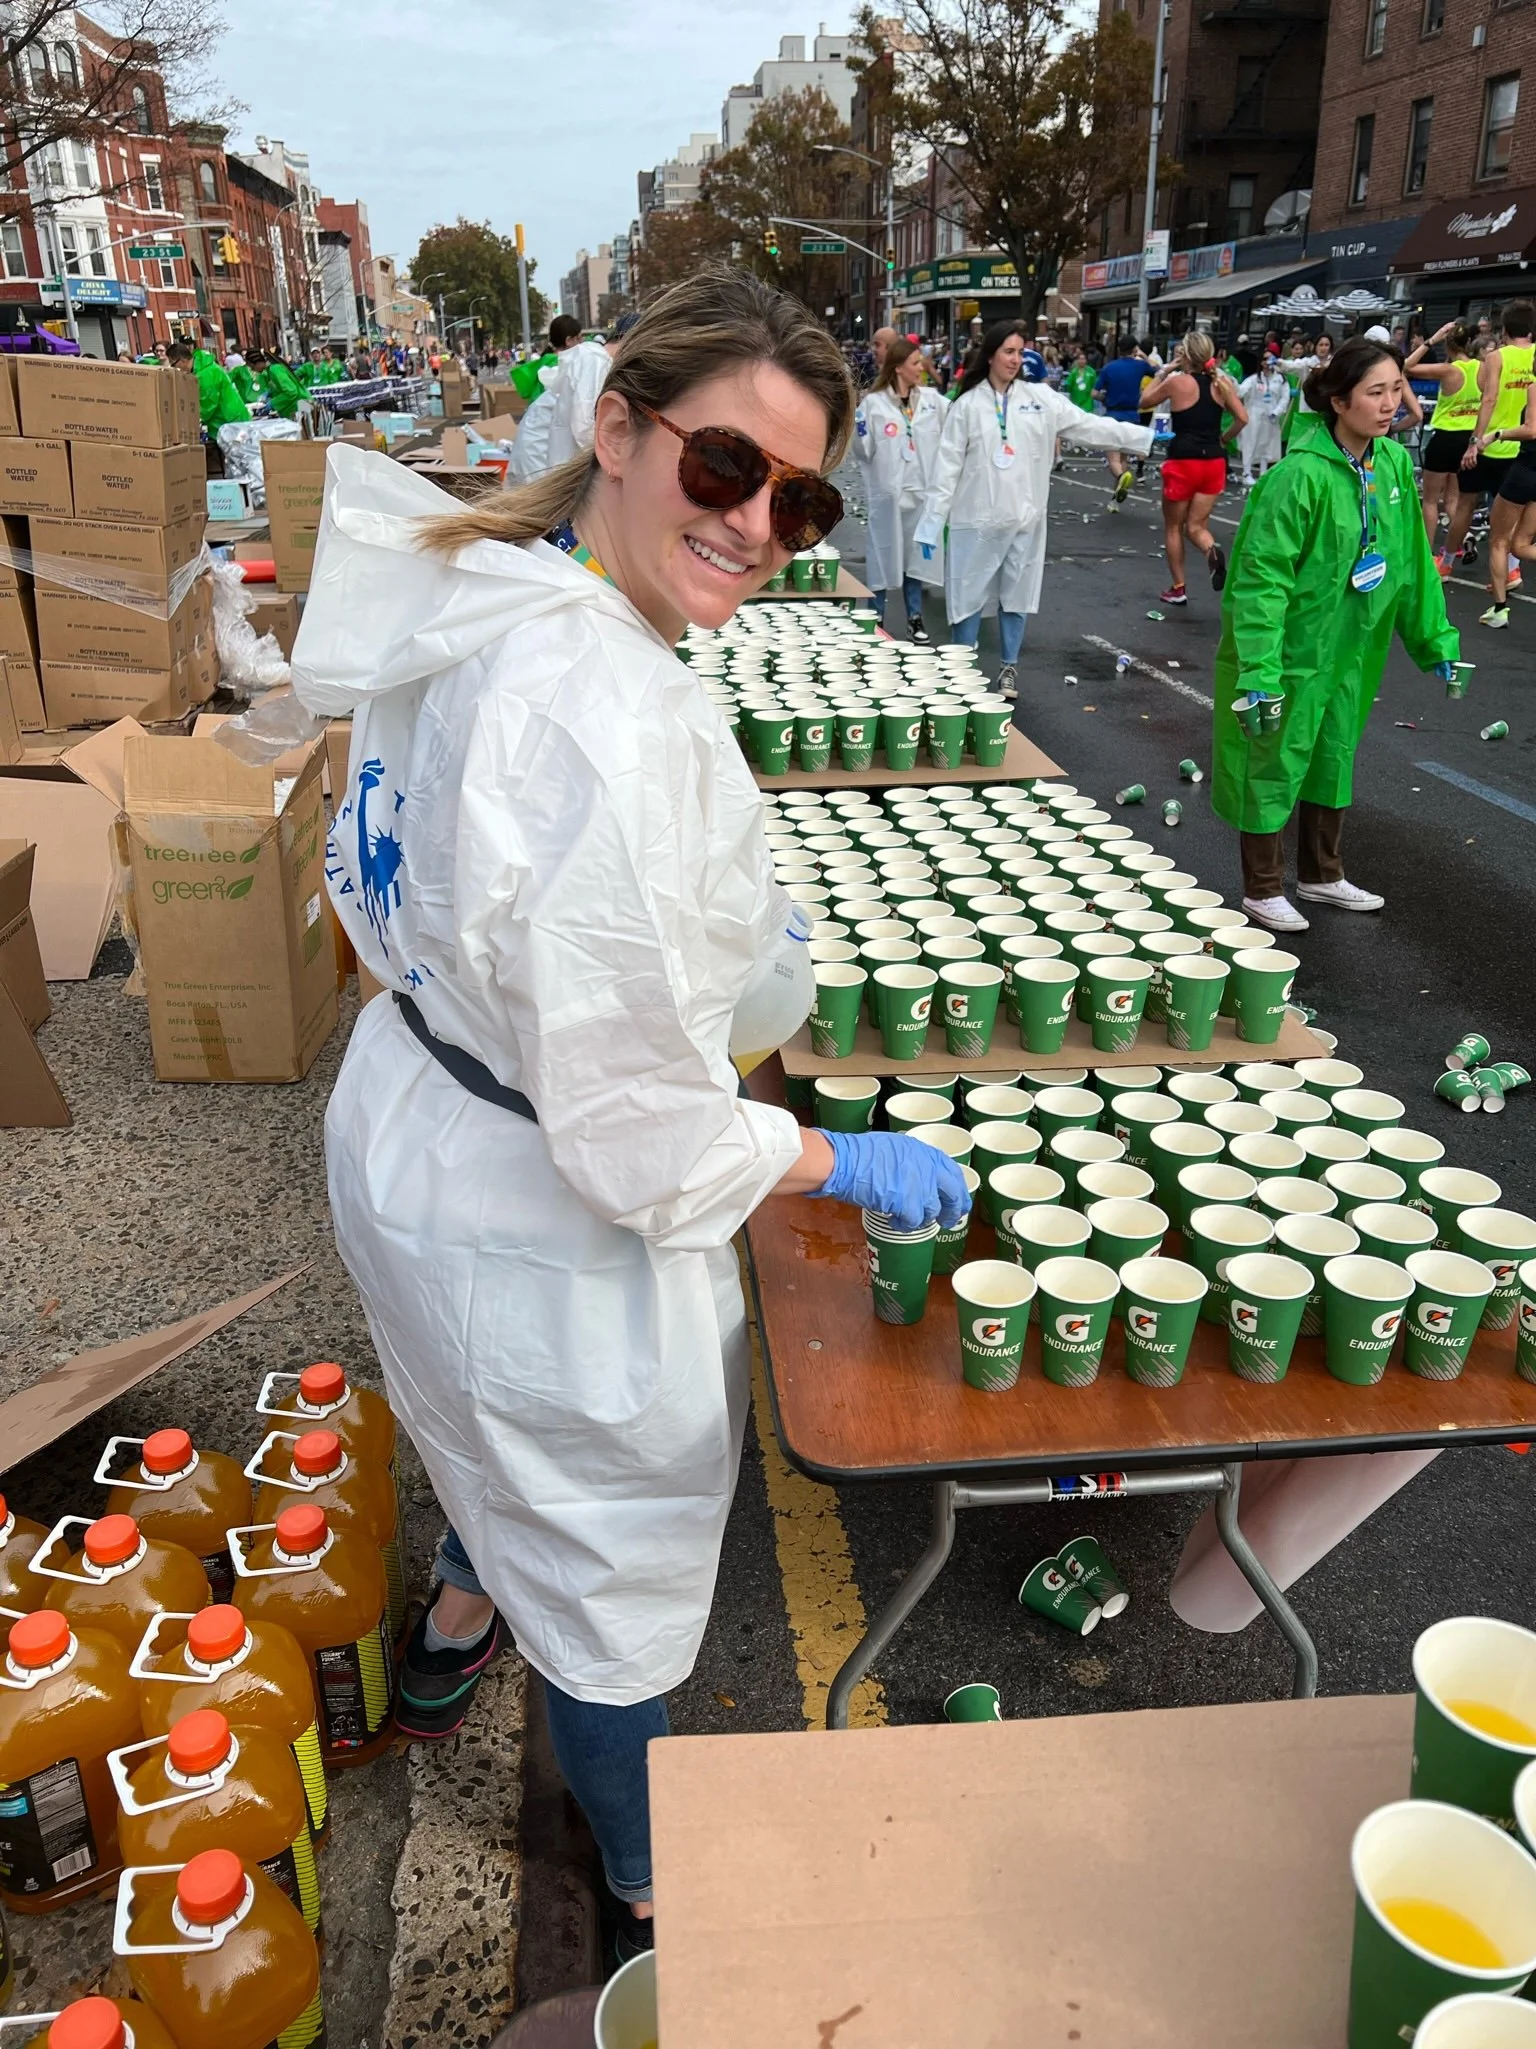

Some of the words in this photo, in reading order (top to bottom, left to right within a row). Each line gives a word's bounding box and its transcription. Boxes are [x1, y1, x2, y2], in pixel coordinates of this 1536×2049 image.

[142, 249, 156, 257] 23
[159, 248, 171, 257] St
[1332, 246, 1346, 258] TIN
[1347, 242, 1366, 256] CUP
[981, 276, 993, 287] ON
[994, 276, 1010, 287] THE
[64, 424, 94, 432] BOTTLED
[96, 426, 118, 434] WATER
[6, 468, 38, 476] BOTTLED
[10, 474, 34, 482] WATER
[102, 474, 134, 484] BOTTLED
[106, 482, 130, 490] WATER
[806, 725, 825, 744] G
[846, 725, 866, 743] G
[800, 742, 830, 750] ENDURANCE
[842, 742, 872, 750] ENDURANCE
[183, 982, 208, 990] Green
[209, 984, 256, 992] Enterprises,
[166, 1000, 186, 1008] Boca
[946, 994, 971, 1018] G
[1106, 990, 1136, 1014] G
[1096, 1011, 1142, 1023] ENDURANCE
[1122, 1153, 1148, 1166] ANCE
[1128, 1306, 1158, 1338] G
[1231, 1300, 1259, 1333] G
[1418, 1302, 1453, 1334] G
[972, 1318, 1008, 1346] G
[1056, 1314, 1092, 1342] G
[1406, 1319, 1468, 1347] ENDURANCE
[962, 1337, 1022, 1358] ENDURANCE
[1044, 1333, 1104, 1354] ENDURANCE
[1042, 1568, 1066, 1591] G
[1082, 1566, 1102, 1588] RANCE
[69, 1776, 78, 1784] 90
